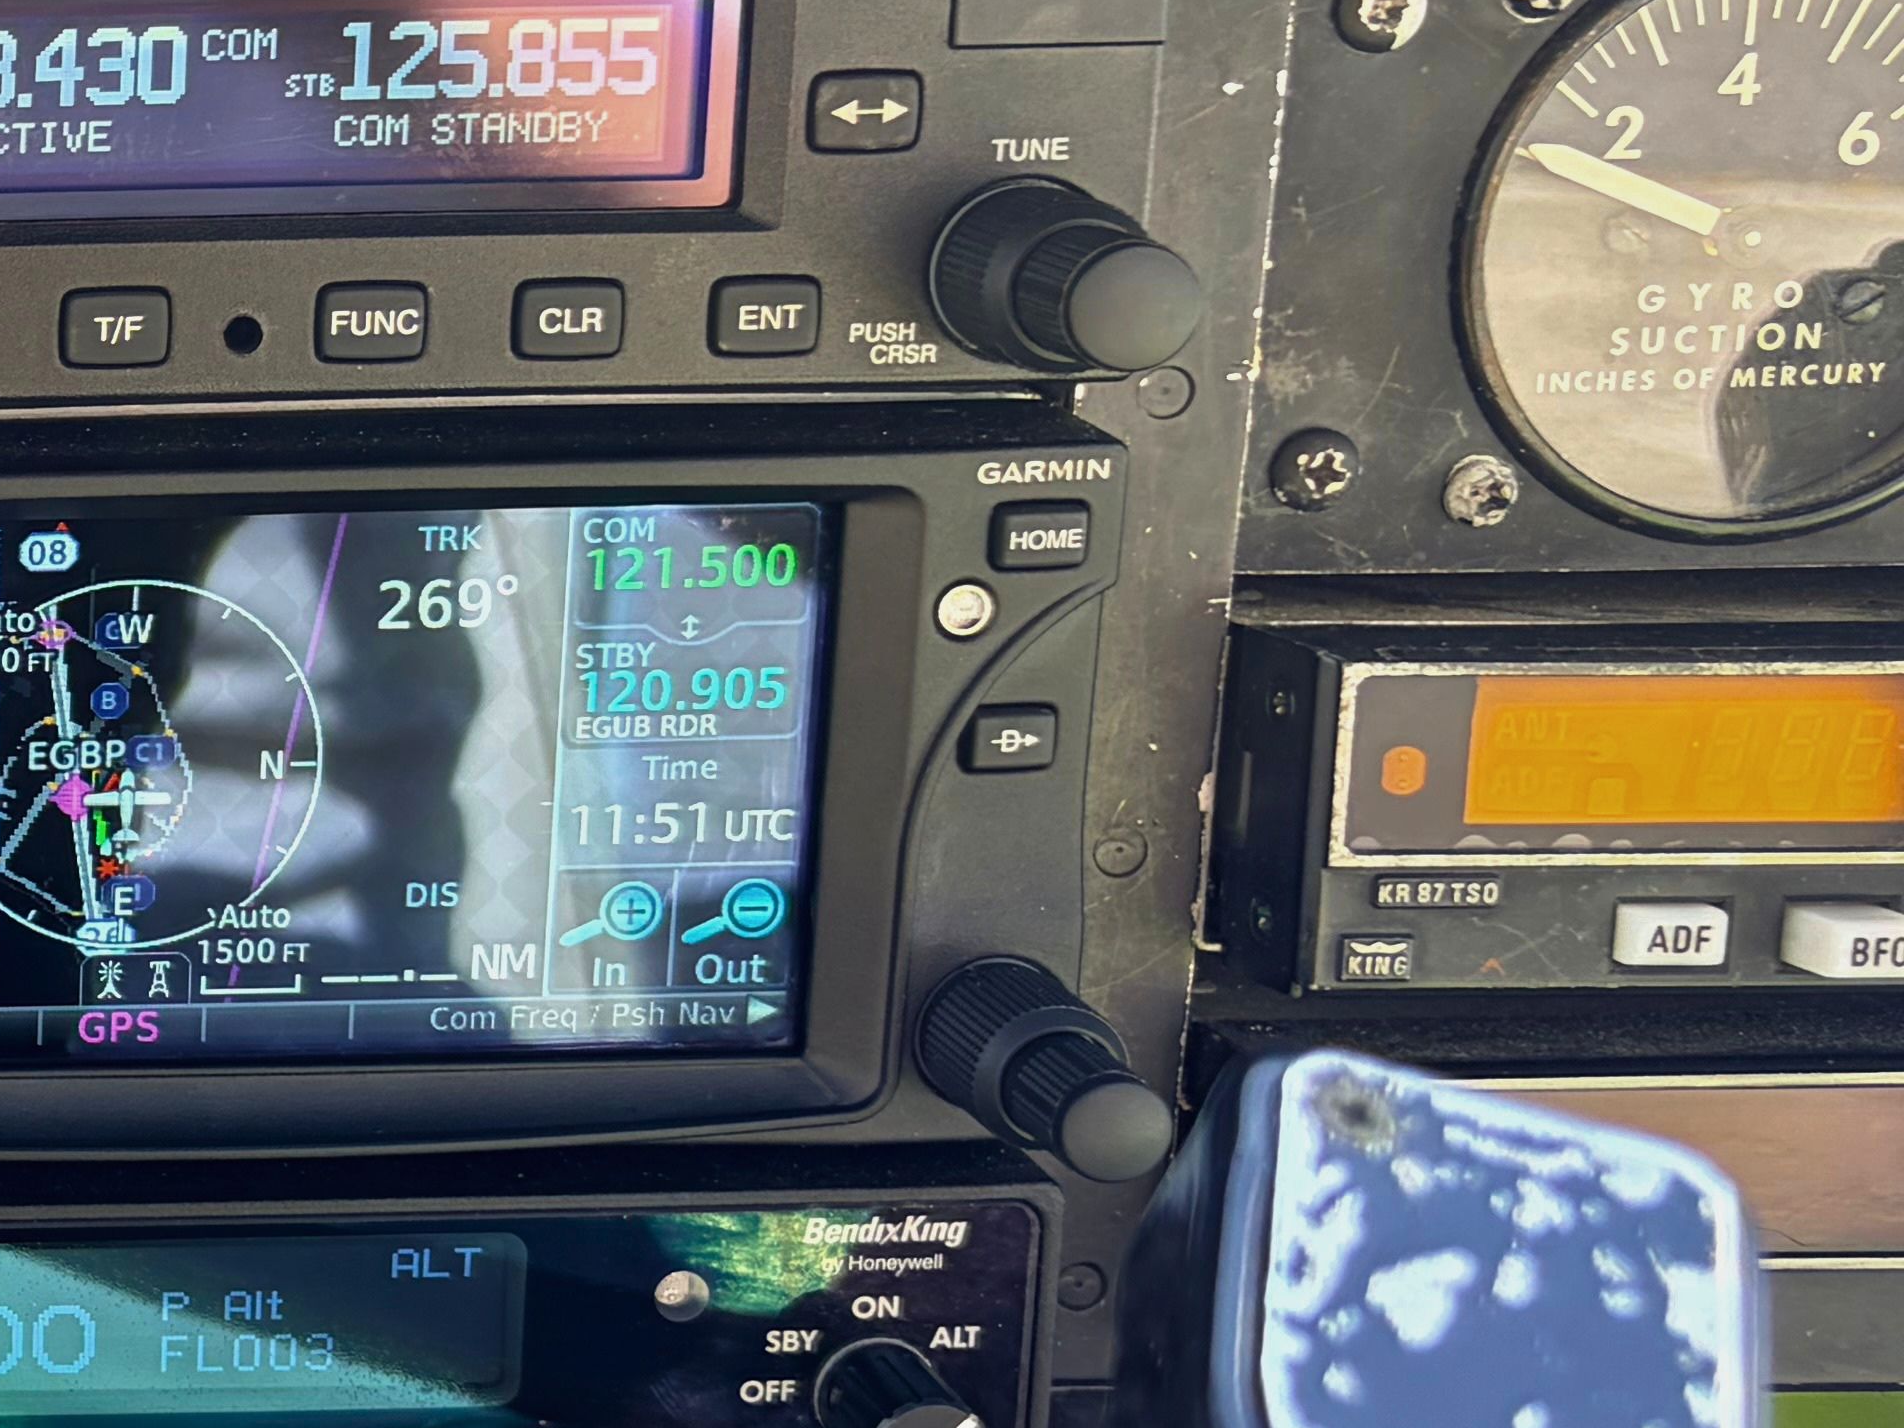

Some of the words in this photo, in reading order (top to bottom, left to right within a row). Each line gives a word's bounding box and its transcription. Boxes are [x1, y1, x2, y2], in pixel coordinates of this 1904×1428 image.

[339, 16, 660, 101] 125.855
[334, 113, 410, 148] COM
[430, 111, 610, 146] STANDBY
[991, 137, 1071, 163] TUNE
[1638, 280, 1805, 313] GYRO
[329, 307, 421, 338] FUNC
[1609, 322, 1823, 356] SUCTION
[1536, 370, 1655, 394] INCHES
[1674, 368, 1714, 392] OF
[1730, 361, 1886, 389] MERCURY
[1008, 527, 1084, 552] HOME
[586, 542, 799, 592] 121.500
[575, 715, 651, 740] EGUB
[660, 713, 718, 737] RDR
[28, 739, 127, 770] EGBP
[642, 755, 719, 781] Time
[571, 801, 708, 847] 11:51
[723, 808, 797, 843] UTC
[1378, 882, 1411, 905] KR
[1418, 882, 1446, 904] 87
[1452, 881, 1499, 905] TSO
[1646, 924, 1713, 954] ADF
[77, 1012, 161, 1045] GPS
[848, 1252, 944, 1274] Honeywell
[765, 1328, 820, 1355] SBY
[739, 1380, 796, 1404] OFF
